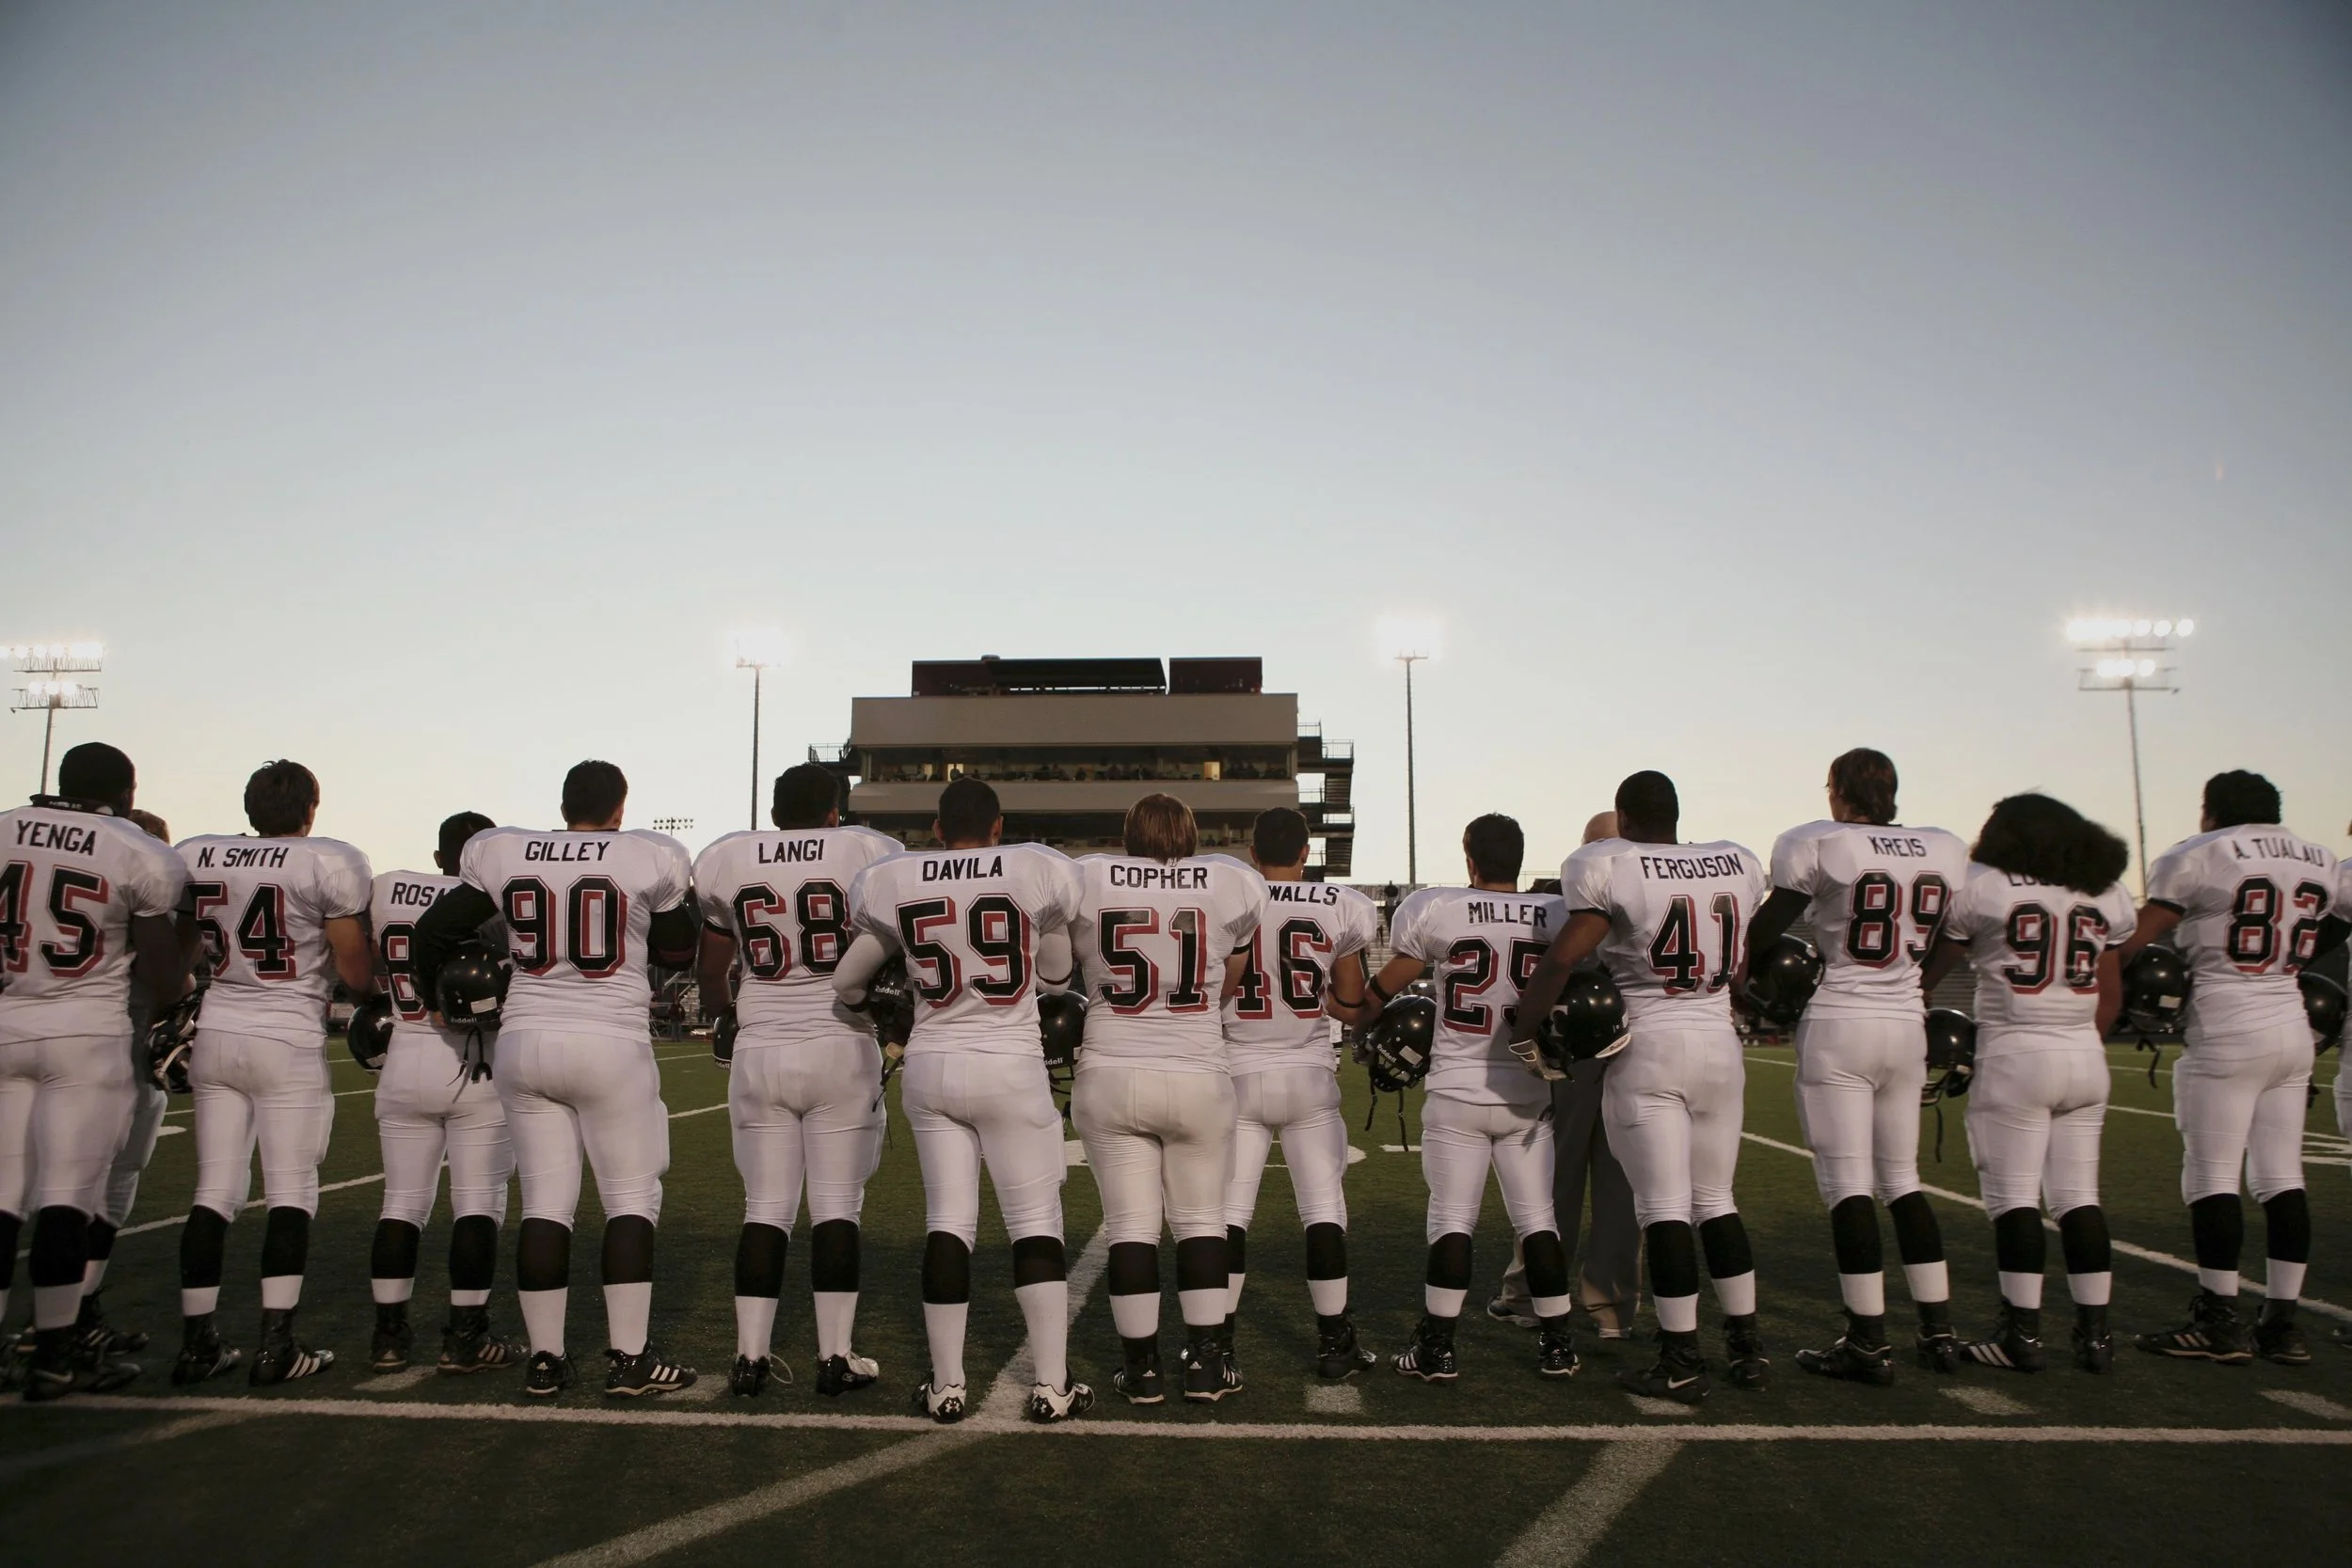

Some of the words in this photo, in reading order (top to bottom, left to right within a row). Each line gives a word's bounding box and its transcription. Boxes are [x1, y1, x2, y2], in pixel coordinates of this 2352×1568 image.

[16, 819, 98, 856] YENGA
[197, 847, 215, 868] N.
[223, 847, 290, 868] SMITH
[524, 840, 611, 862] GILLEY
[757, 838, 824, 863] LANGI
[922, 855, 1004, 882] DAVILA
[1640, 852, 1745, 880] FERGUSON
[1867, 835, 1928, 858] KREIS
[1110, 863, 1208, 890] COPHER
[1268, 884, 1341, 907] WALLS
[0, 859, 109, 978] 45
[184, 880, 297, 981] 54
[500, 874, 628, 979] 90
[730, 878, 852, 982] 68
[1467, 901, 1548, 928] MILLER
[1646, 892, 1740, 995] 41
[1844, 868, 1952, 970] 89
[2002, 899, 2110, 995] 96
[2224, 873, 2328, 974] 82
[895, 892, 1033, 1009] 59
[1097, 906, 1209, 1016] 51
